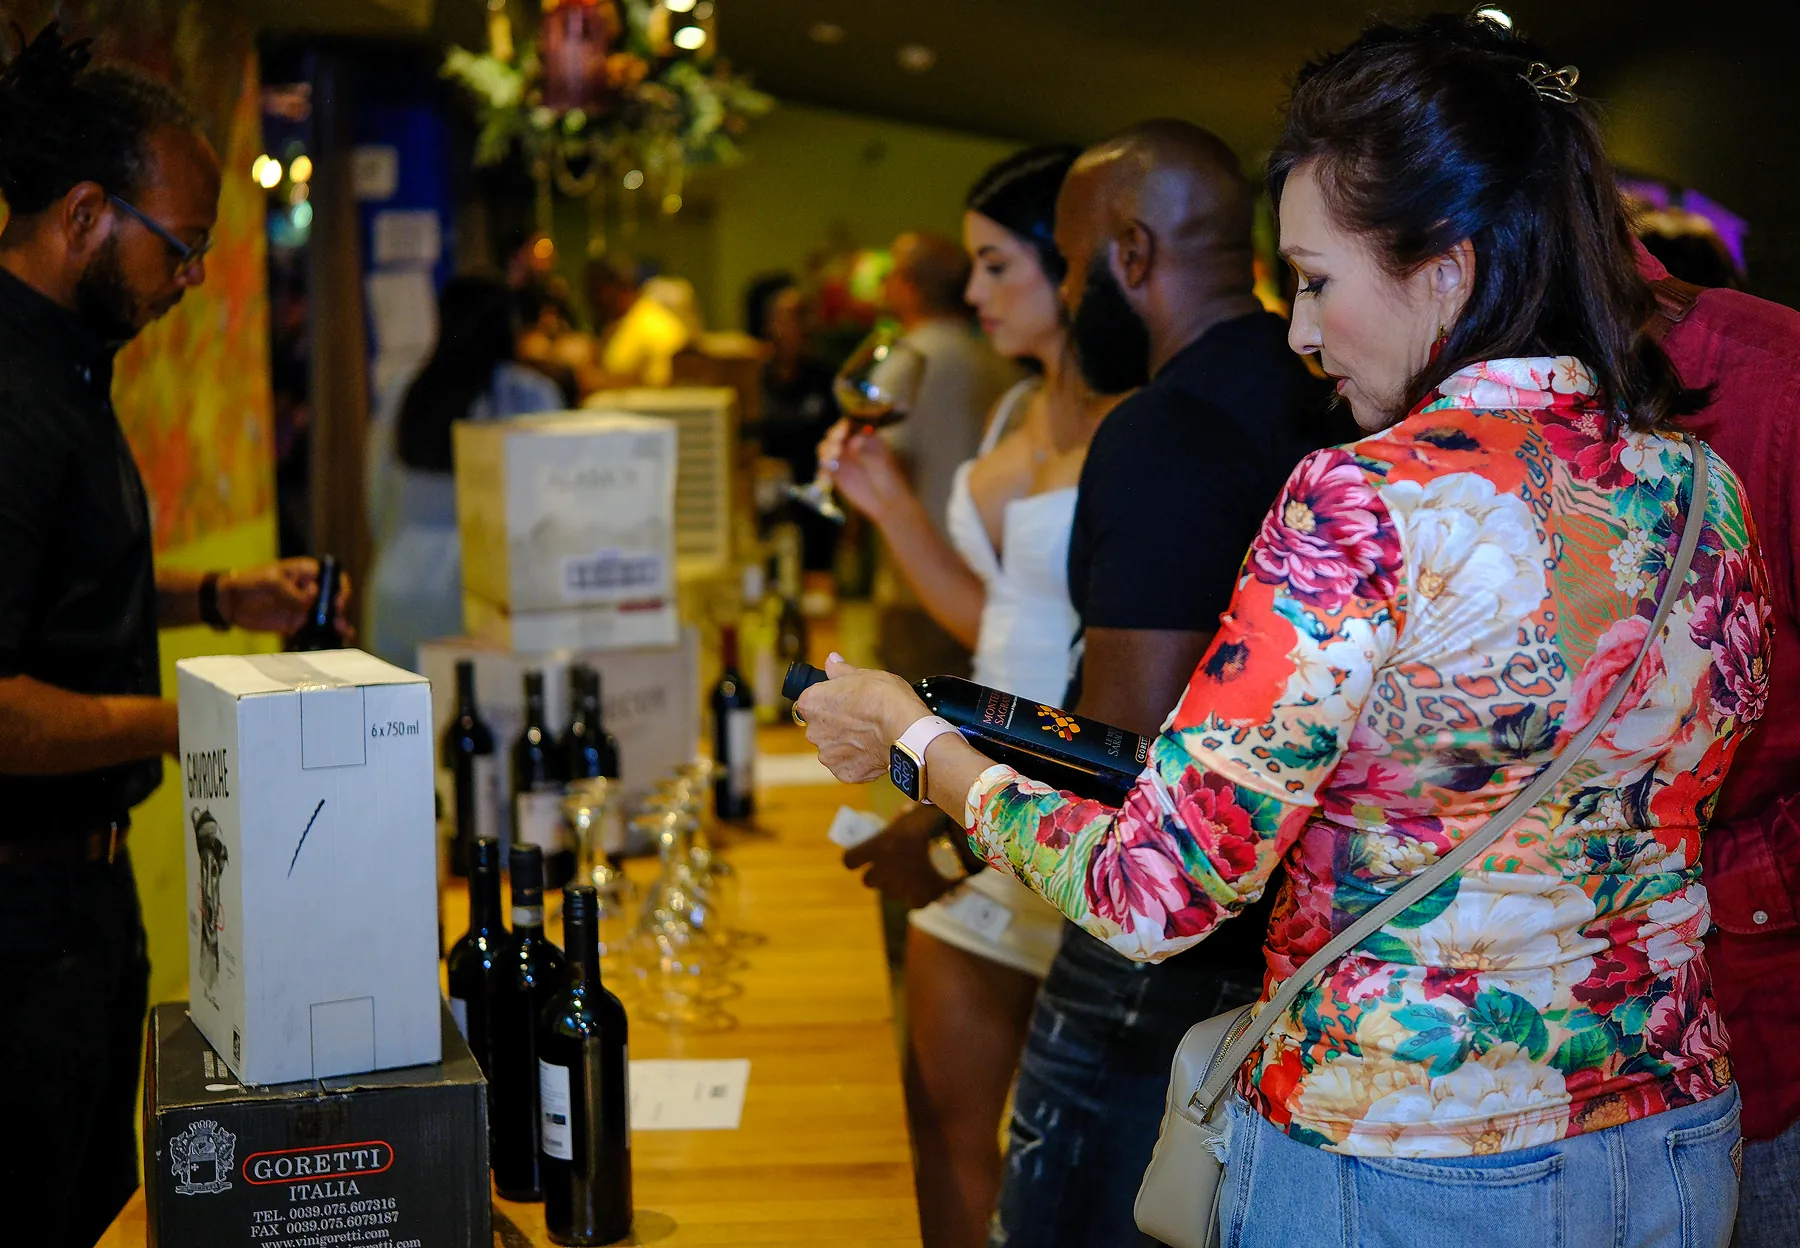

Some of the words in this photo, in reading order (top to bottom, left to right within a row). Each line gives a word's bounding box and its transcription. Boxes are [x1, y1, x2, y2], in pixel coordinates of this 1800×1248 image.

[386, 721, 405, 737] 750
[406, 719, 419, 735] ml
[187, 748, 230, 799] GAVROCHE
[254, 1148, 381, 1180] GORETTI
[289, 1179, 361, 1202] ITALIA
[250, 1223, 280, 1238] FAX
[286, 1210, 400, 1235] 0039.075.6079187
[253, 1208, 287, 1224] TEL.
[289, 1197, 397, 1221] 0039.075.607316
[260, 1227, 390, 1248] www.vinigoretti.com
